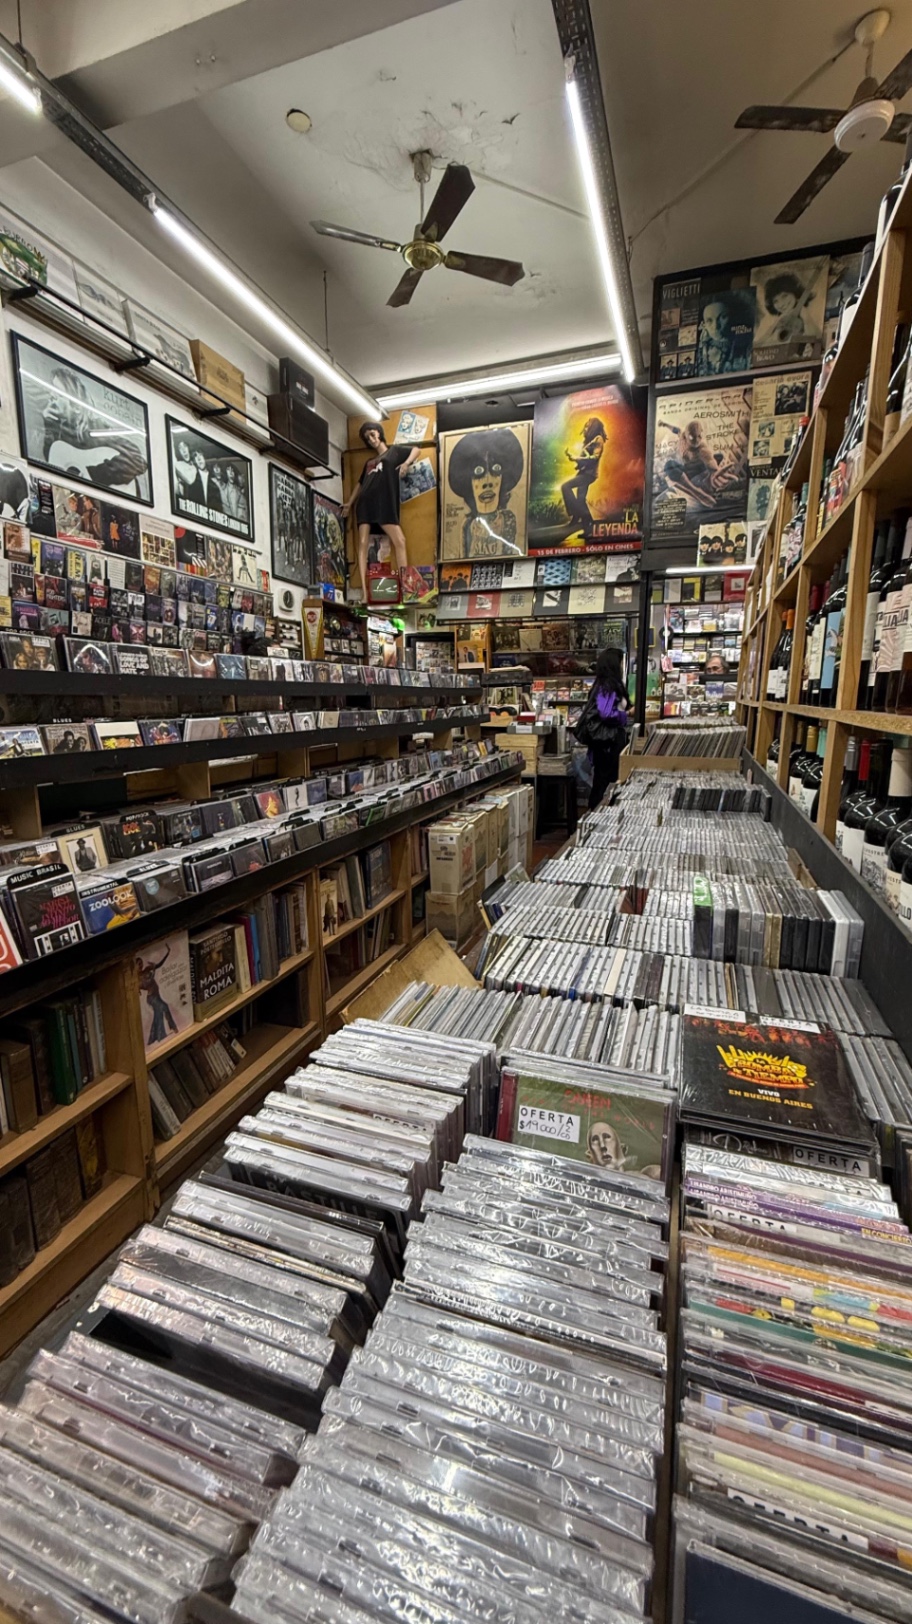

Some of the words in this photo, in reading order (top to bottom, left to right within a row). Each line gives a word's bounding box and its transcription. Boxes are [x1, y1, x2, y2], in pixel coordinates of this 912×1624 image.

[662, 283, 700, 299] VIGLIETTI
[692, 410, 751, 419] AEROSMITH
[717, 423, 734, 431] THE
[625, 511, 639, 523] LA
[592, 522, 638, 537] LEYENDA
[554, 547, 580, 555] FEBRERO
[586, 544, 603, 552] SÓLO
[65, 824, 86, 834] BLUES
[10, 872, 33, 884] MUSIC
[88, 890, 133, 912] ZOOLOOK
[200, 962, 235, 988] MALDITA
[204, 976, 232, 1000] ROMA
[728, 1088, 742, 1096] EN
[743, 1090, 782, 1104] BUENOS
[783, 1098, 814, 1110] AIRES
[757, 1088, 781, 1098] VIVO
[520, 1107, 574, 1127] OFERTA
[795, 1149, 862, 1172] OFERTA
